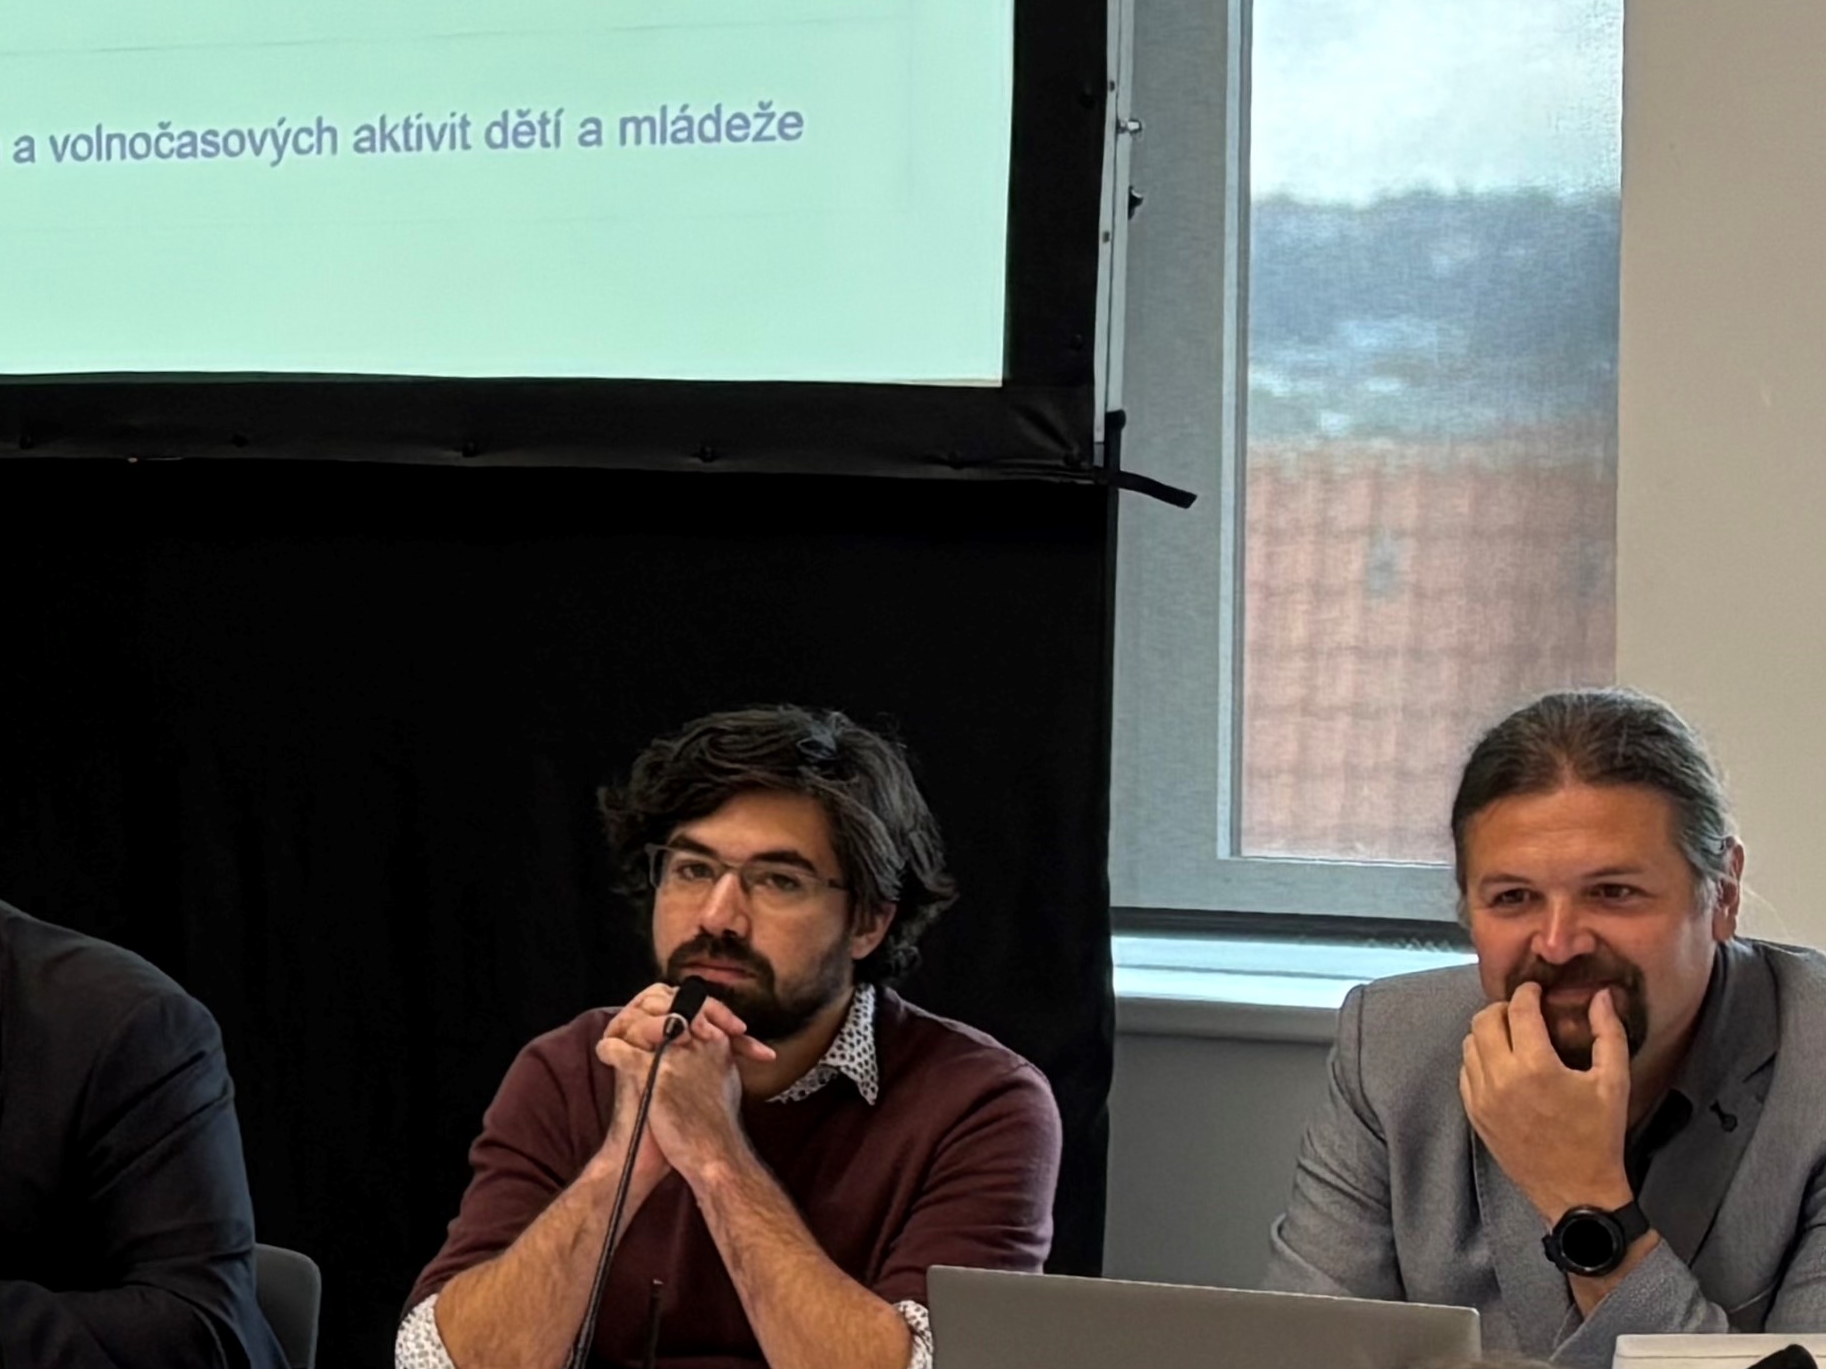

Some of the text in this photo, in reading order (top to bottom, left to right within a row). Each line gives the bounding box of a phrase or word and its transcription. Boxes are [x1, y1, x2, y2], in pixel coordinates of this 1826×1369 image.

[12, 133, 37, 165] a
[48, 114, 338, 168] volnočasových
[352, 111, 473, 154] aktivit
[483, 107, 565, 150] dětí
[577, 115, 604, 148] a
[619, 99, 805, 147] mládeže
